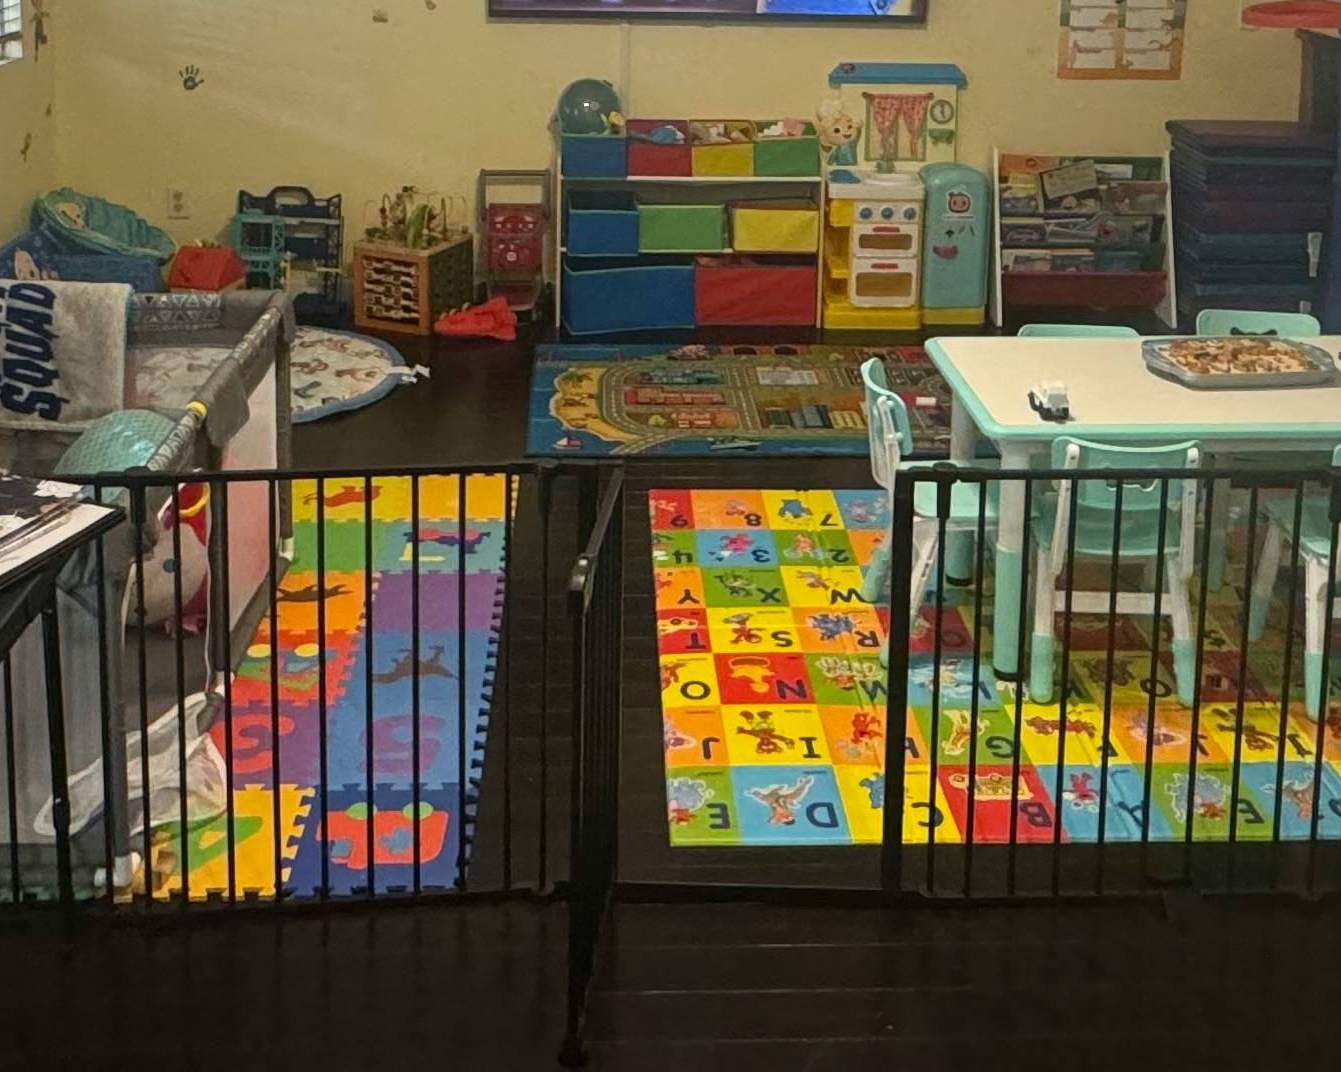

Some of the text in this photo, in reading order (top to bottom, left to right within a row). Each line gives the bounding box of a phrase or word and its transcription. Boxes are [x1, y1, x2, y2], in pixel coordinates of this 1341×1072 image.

[0, 283, 70, 420] SQUAD
[744, 513, 762, 527] 8
[820, 514, 839, 527] 7
[672, 549, 849, 564] 4 3 2
[678, 589, 700, 604] Y
[757, 588, 781, 603] X
[685, 631, 880, 649] T S R
[680, 680, 711, 700] O
[776, 679, 807, 700] N
[1140, 678, 1172, 698] O
[702, 737, 720, 759] J
[799, 737, 821, 758] I
[985, 736, 1015, 759] G
[706, 803, 730, 829] E
[806, 802, 839, 829] D
[911, 801, 944, 828] C
[1020, 801, 1053, 828] B
[1117, 800, 1146, 828] A
